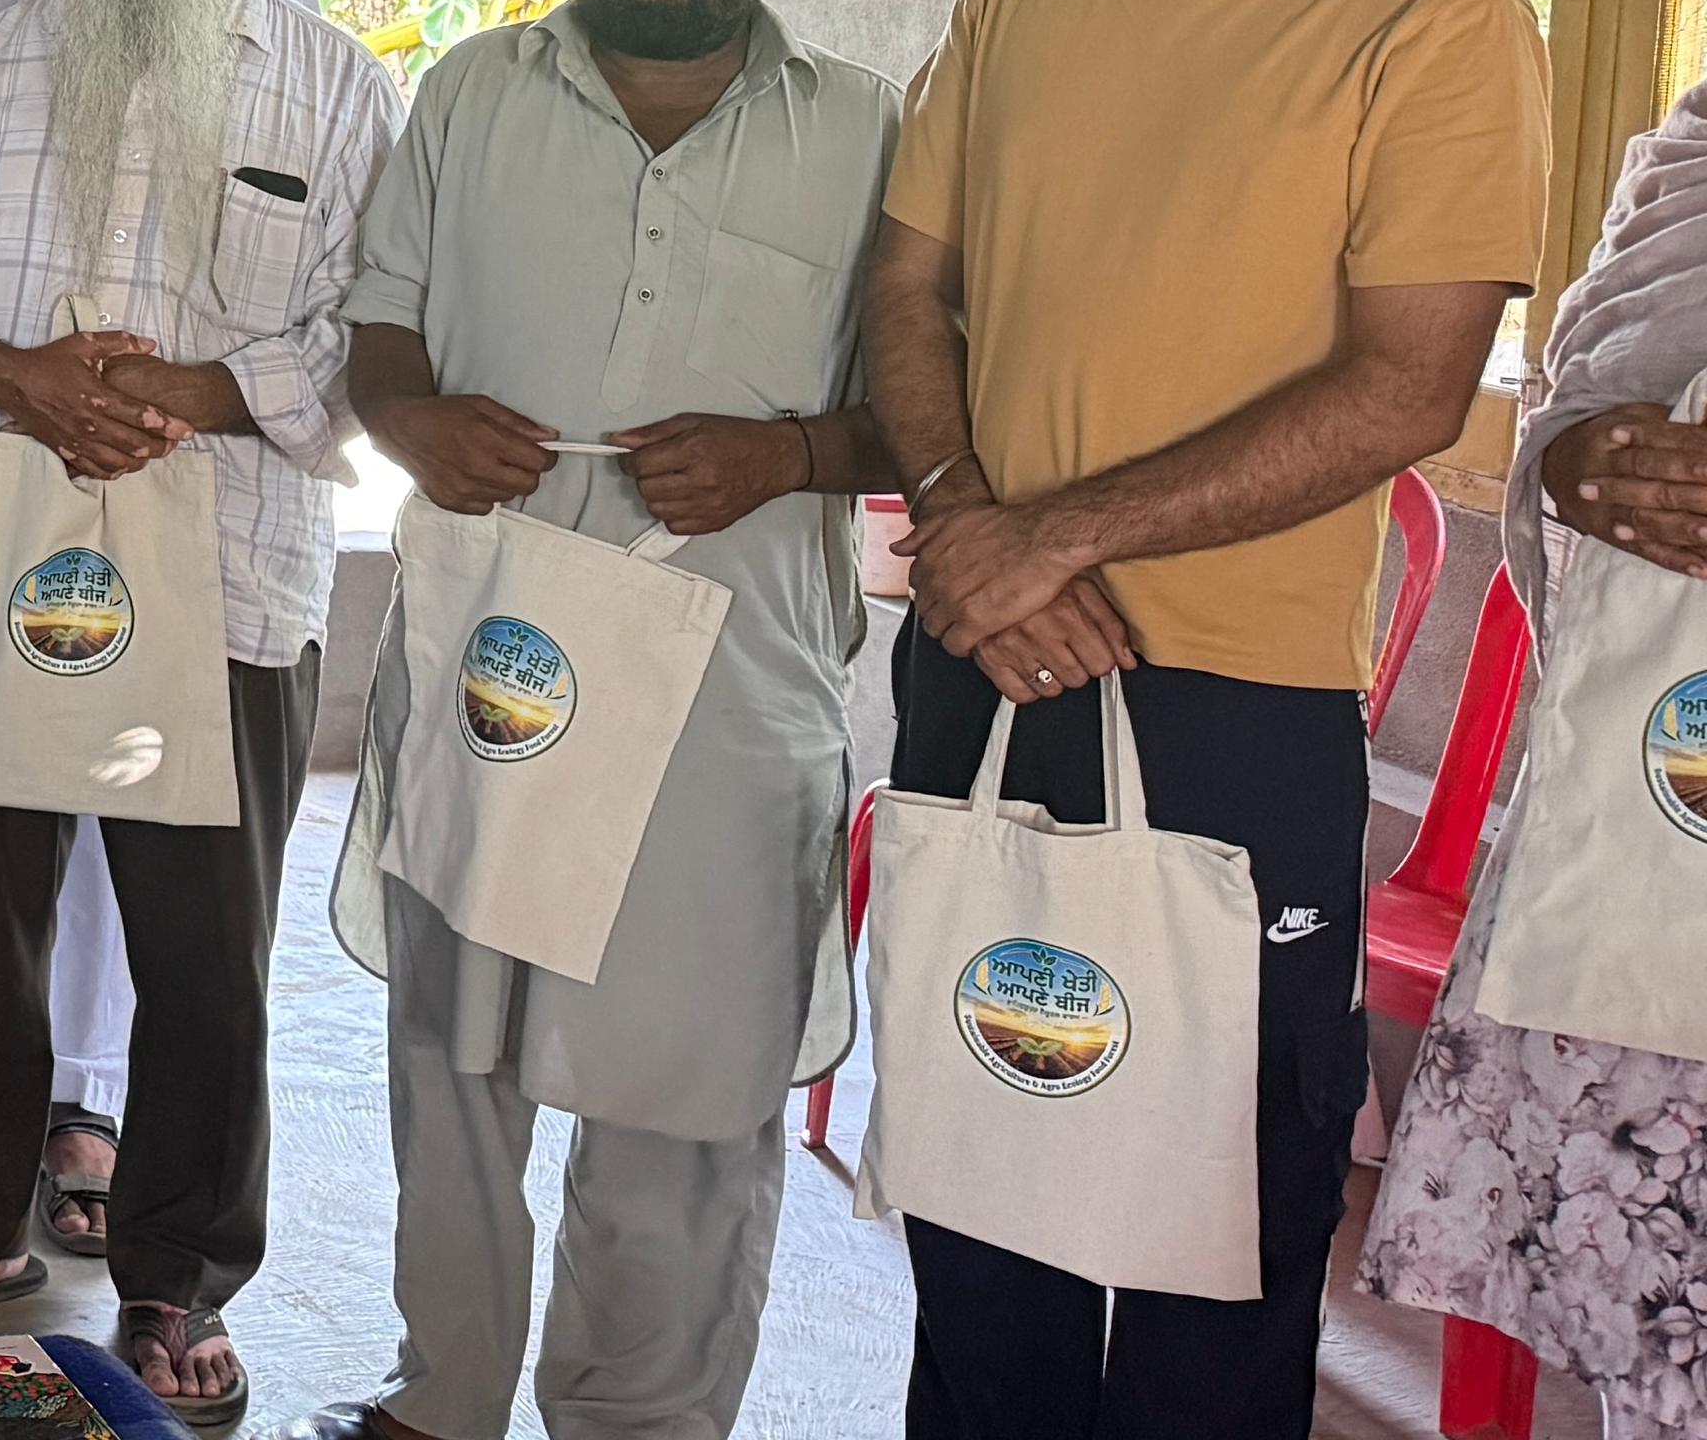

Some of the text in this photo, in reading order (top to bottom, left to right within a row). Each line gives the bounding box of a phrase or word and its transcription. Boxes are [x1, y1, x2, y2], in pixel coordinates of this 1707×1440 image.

[39, 567, 111, 587] ਆਪਣੀ ਖੇਤੀ
[41, 586, 106, 603] ਆਪਣੇ ਬੀਜ
[479, 635, 560, 678] ਆਪਣੀ ਖੇਤੀ
[516, 667, 548, 693] ਬੀਜ
[1278, 906, 1319, 928] NIKE
[992, 958, 1098, 992] ਆਪਣੀ ਖੇਤੀ
[997, 980, 1049, 1006] ਆਪਣੇ
[1055, 992, 1090, 1013] ਬੀਜ
[989, 1056, 1030, 1085] Agriculture
[1040, 1082, 1060, 1091] Agro
[1062, 1074, 1092, 1090] Ecology
